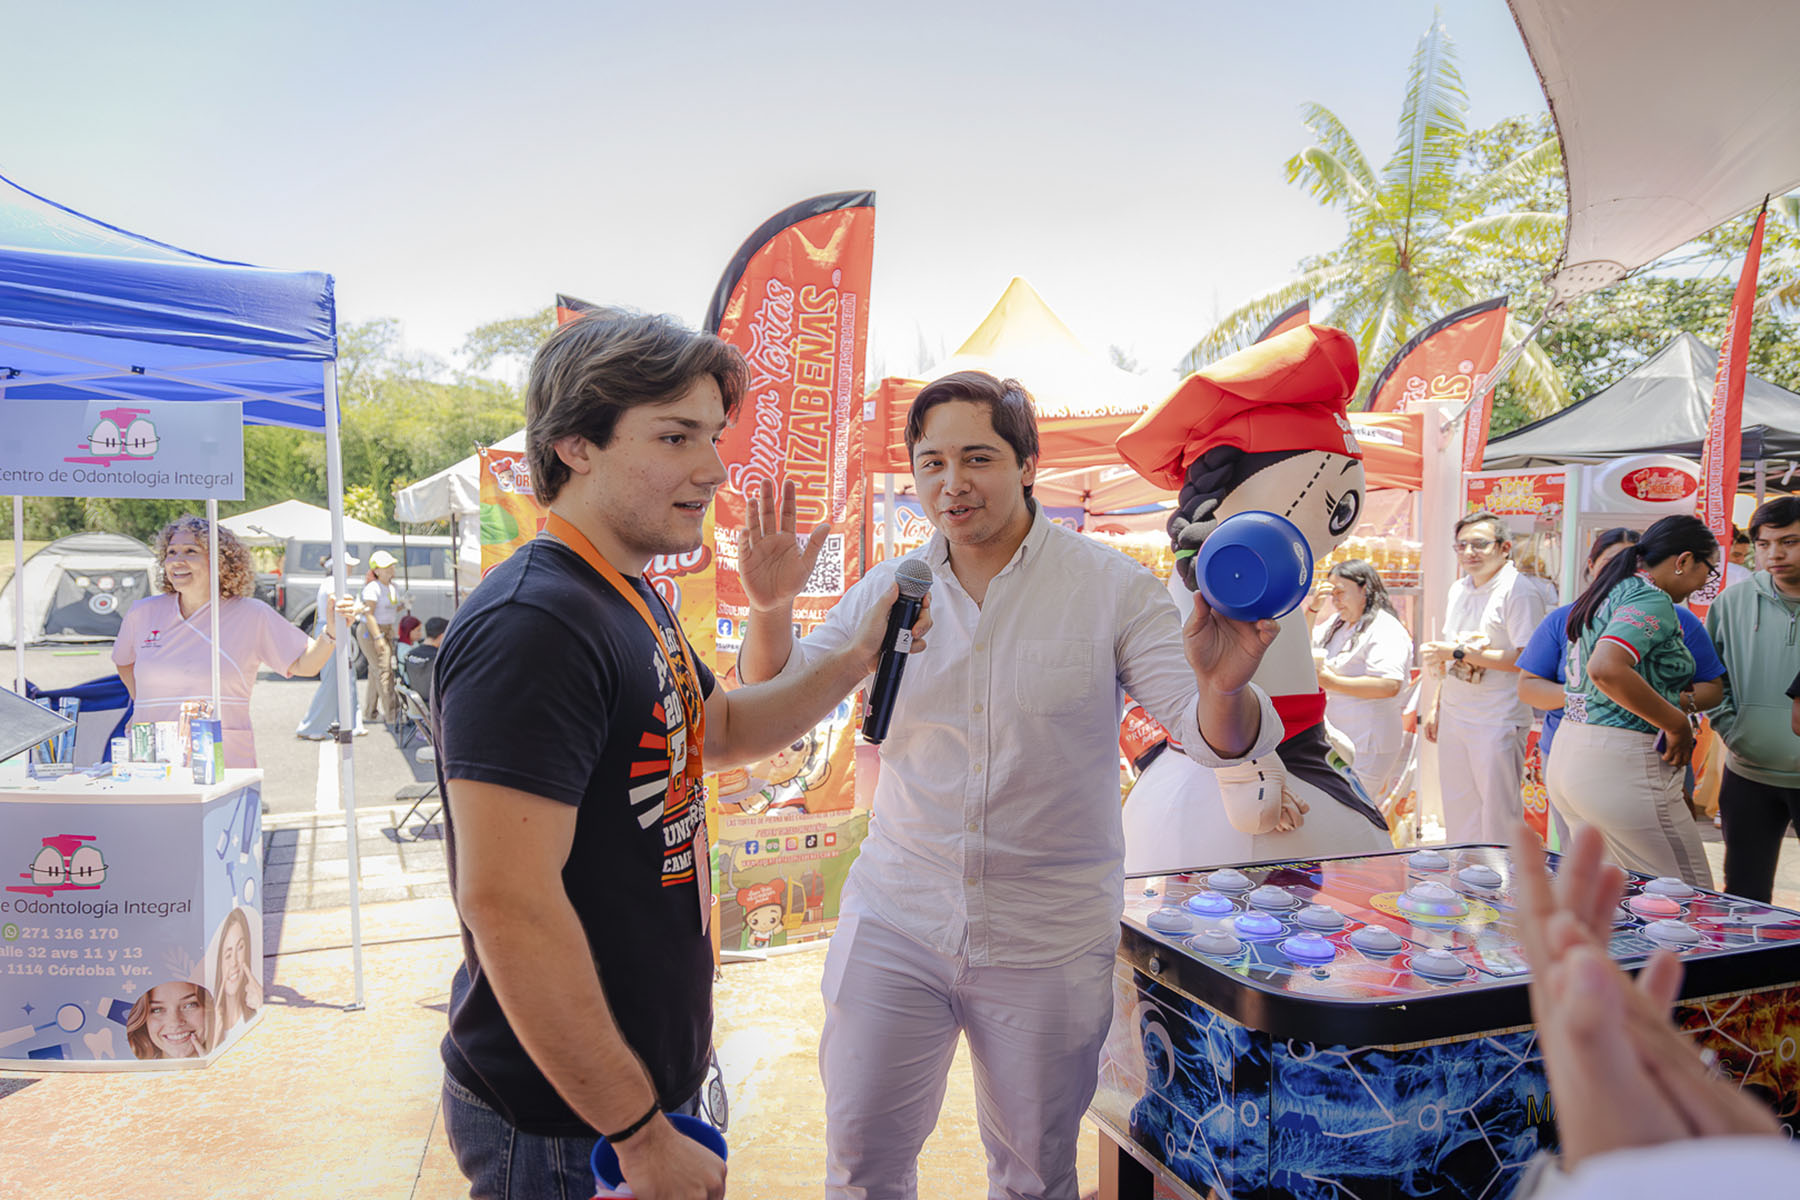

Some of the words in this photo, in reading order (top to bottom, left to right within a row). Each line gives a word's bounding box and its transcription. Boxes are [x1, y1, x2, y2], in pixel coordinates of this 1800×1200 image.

[48, 469, 68, 483] de
[174, 471, 233, 489] Integral
[1708, 486, 1725, 517] TORTAS
[1709, 518, 1725, 536] LAS
[124, 899, 191, 918] Integral
[22, 927, 50, 940] 271
[54, 927, 84, 940] 316
[88, 927, 119, 940] 170
[0, 945, 24, 958] alle
[27, 947, 47, 959] 32
[51, 949, 79, 959] avs
[83, 947, 104, 960] 11
[107, 949, 118, 962] y
[122, 947, 143, 960] 13
[7, 963, 44, 976] 1114
[47, 963, 116, 977] Córdoba
[120, 964, 153, 977] Ver.
